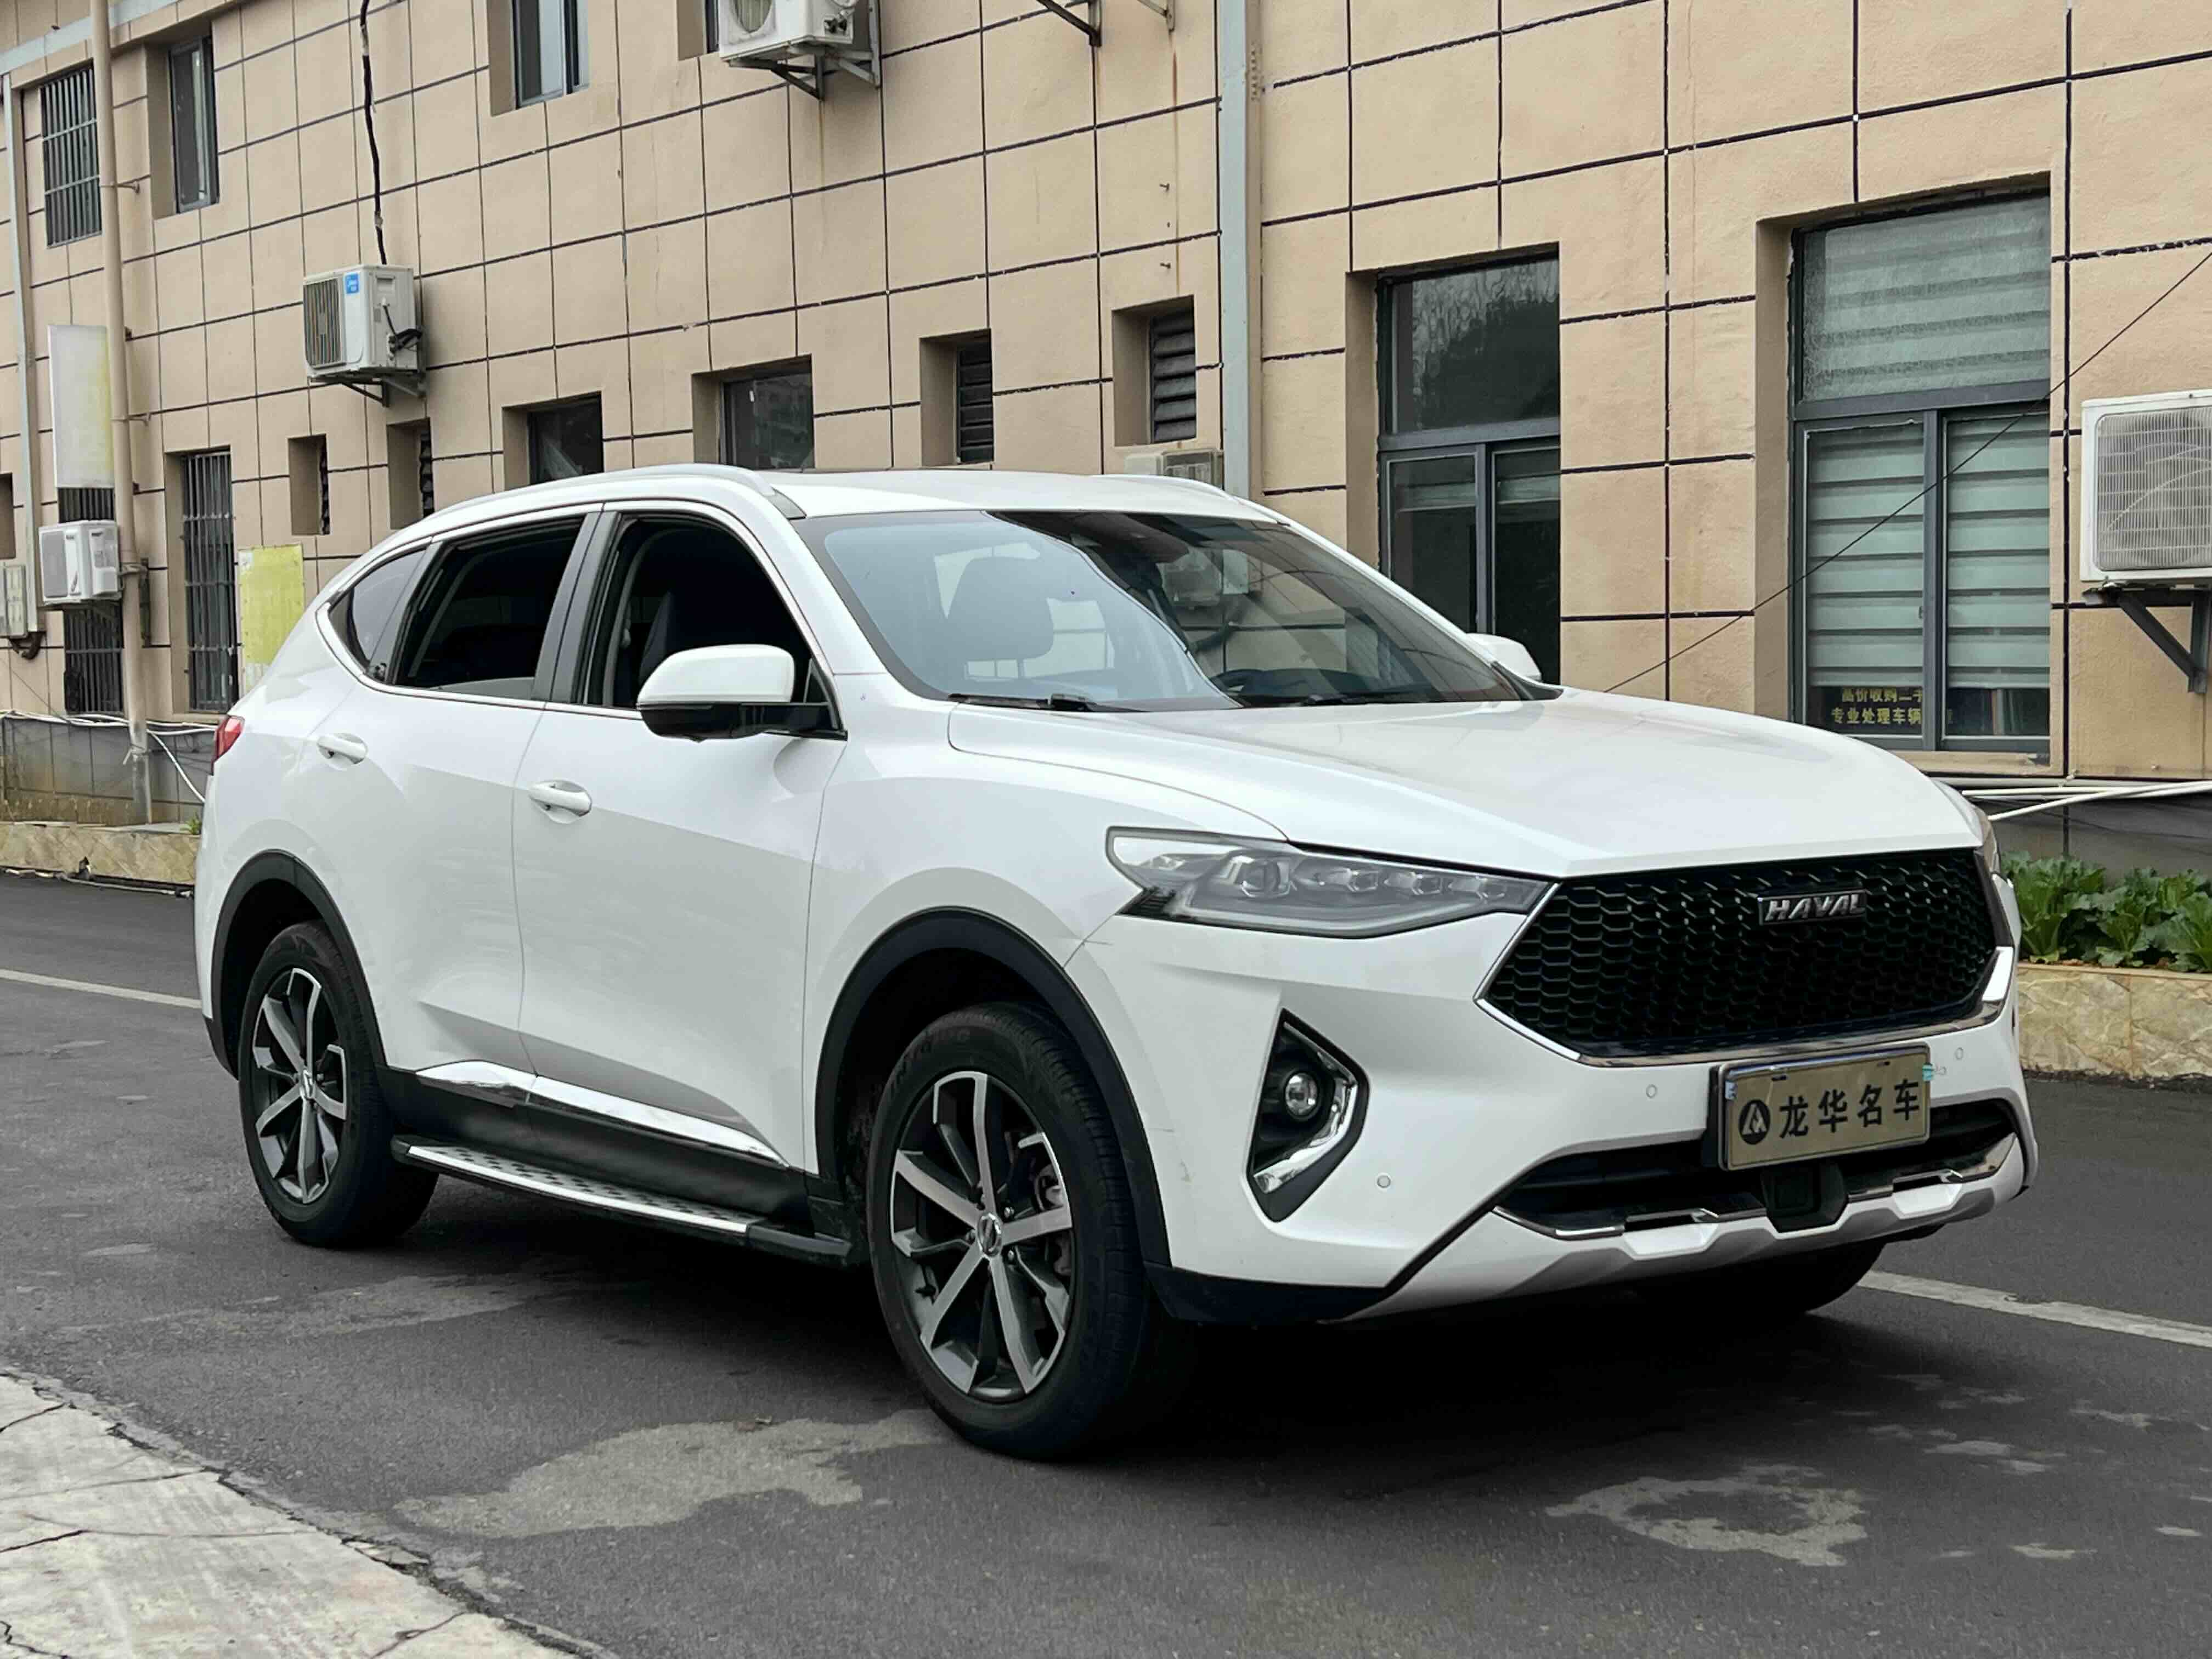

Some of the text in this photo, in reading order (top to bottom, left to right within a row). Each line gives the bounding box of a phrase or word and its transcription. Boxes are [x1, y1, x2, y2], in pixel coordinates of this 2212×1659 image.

[1764, 894, 1865, 921] HAVAL
[1779, 1079, 1920, 1139] 龙华名车
